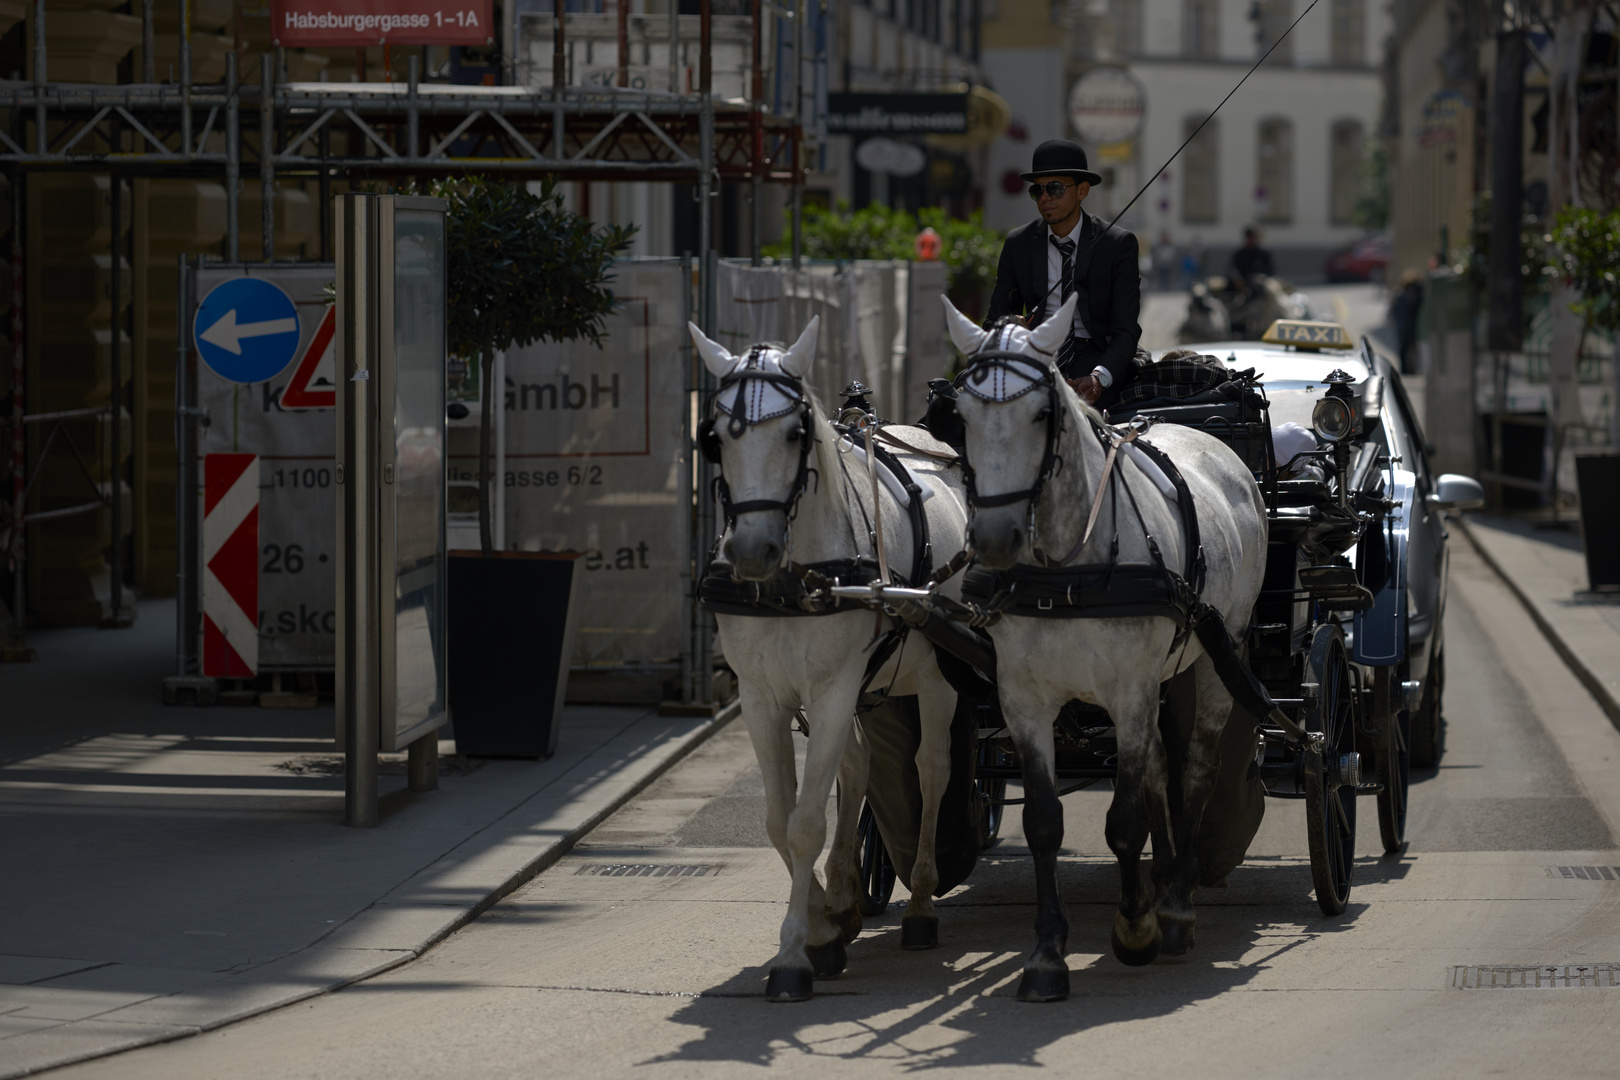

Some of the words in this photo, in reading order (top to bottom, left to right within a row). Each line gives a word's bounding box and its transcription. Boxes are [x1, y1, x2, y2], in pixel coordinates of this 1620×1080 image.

[285, 11, 430, 32] Habsburgergasse
[1280, 326, 1339, 342] TAXI
[275, 468, 330, 488] 1100
[567, 465, 603, 486] 6/2
[263, 544, 304, 574] 26
